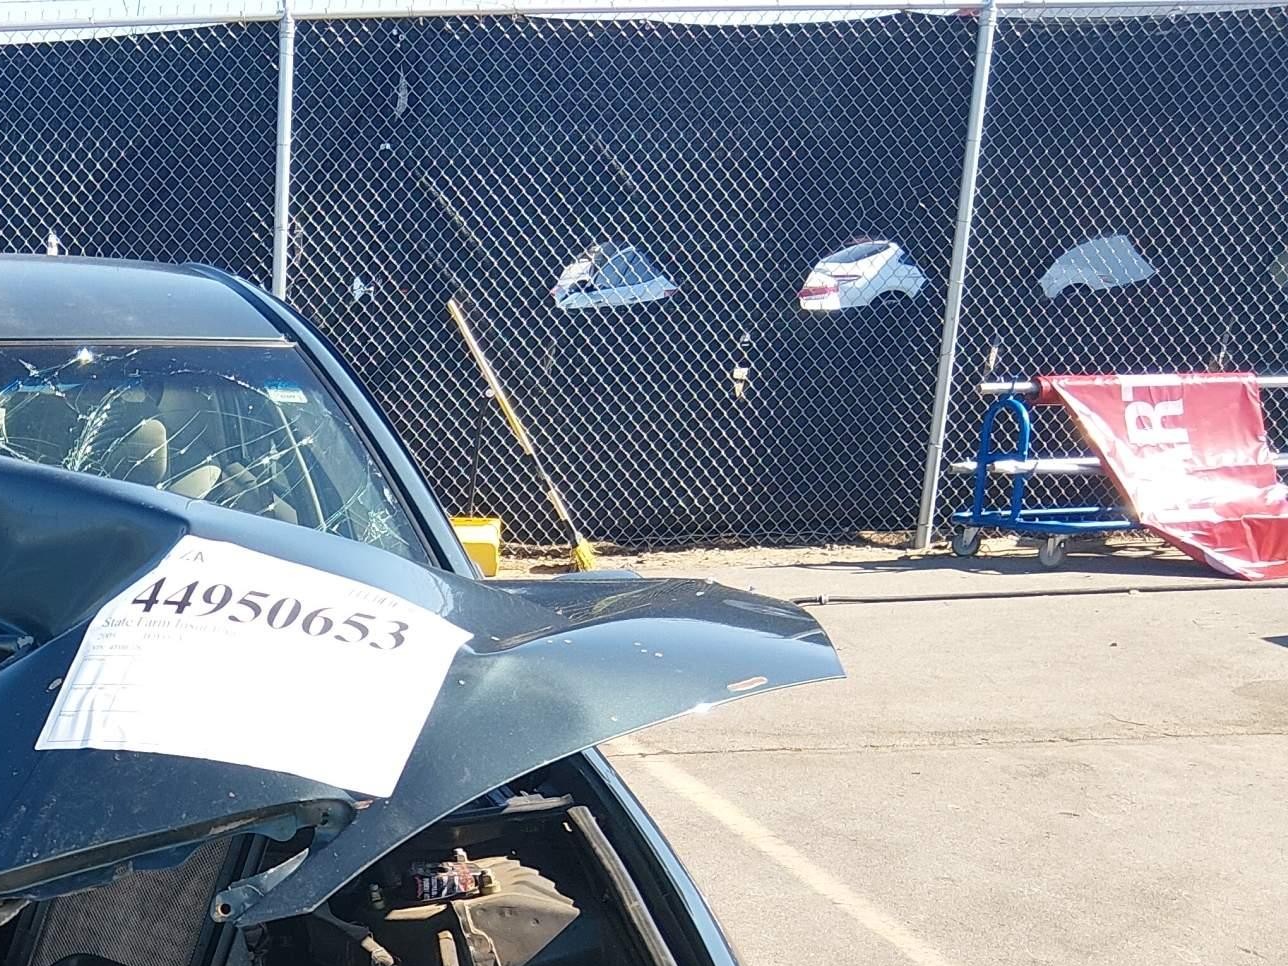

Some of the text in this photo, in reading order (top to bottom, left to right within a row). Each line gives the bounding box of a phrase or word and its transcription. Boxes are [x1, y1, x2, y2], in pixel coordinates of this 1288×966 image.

[101, 616, 132, 628] State
[136, 616, 171, 629] Farm
[131, 576, 410, 651] 44950653
